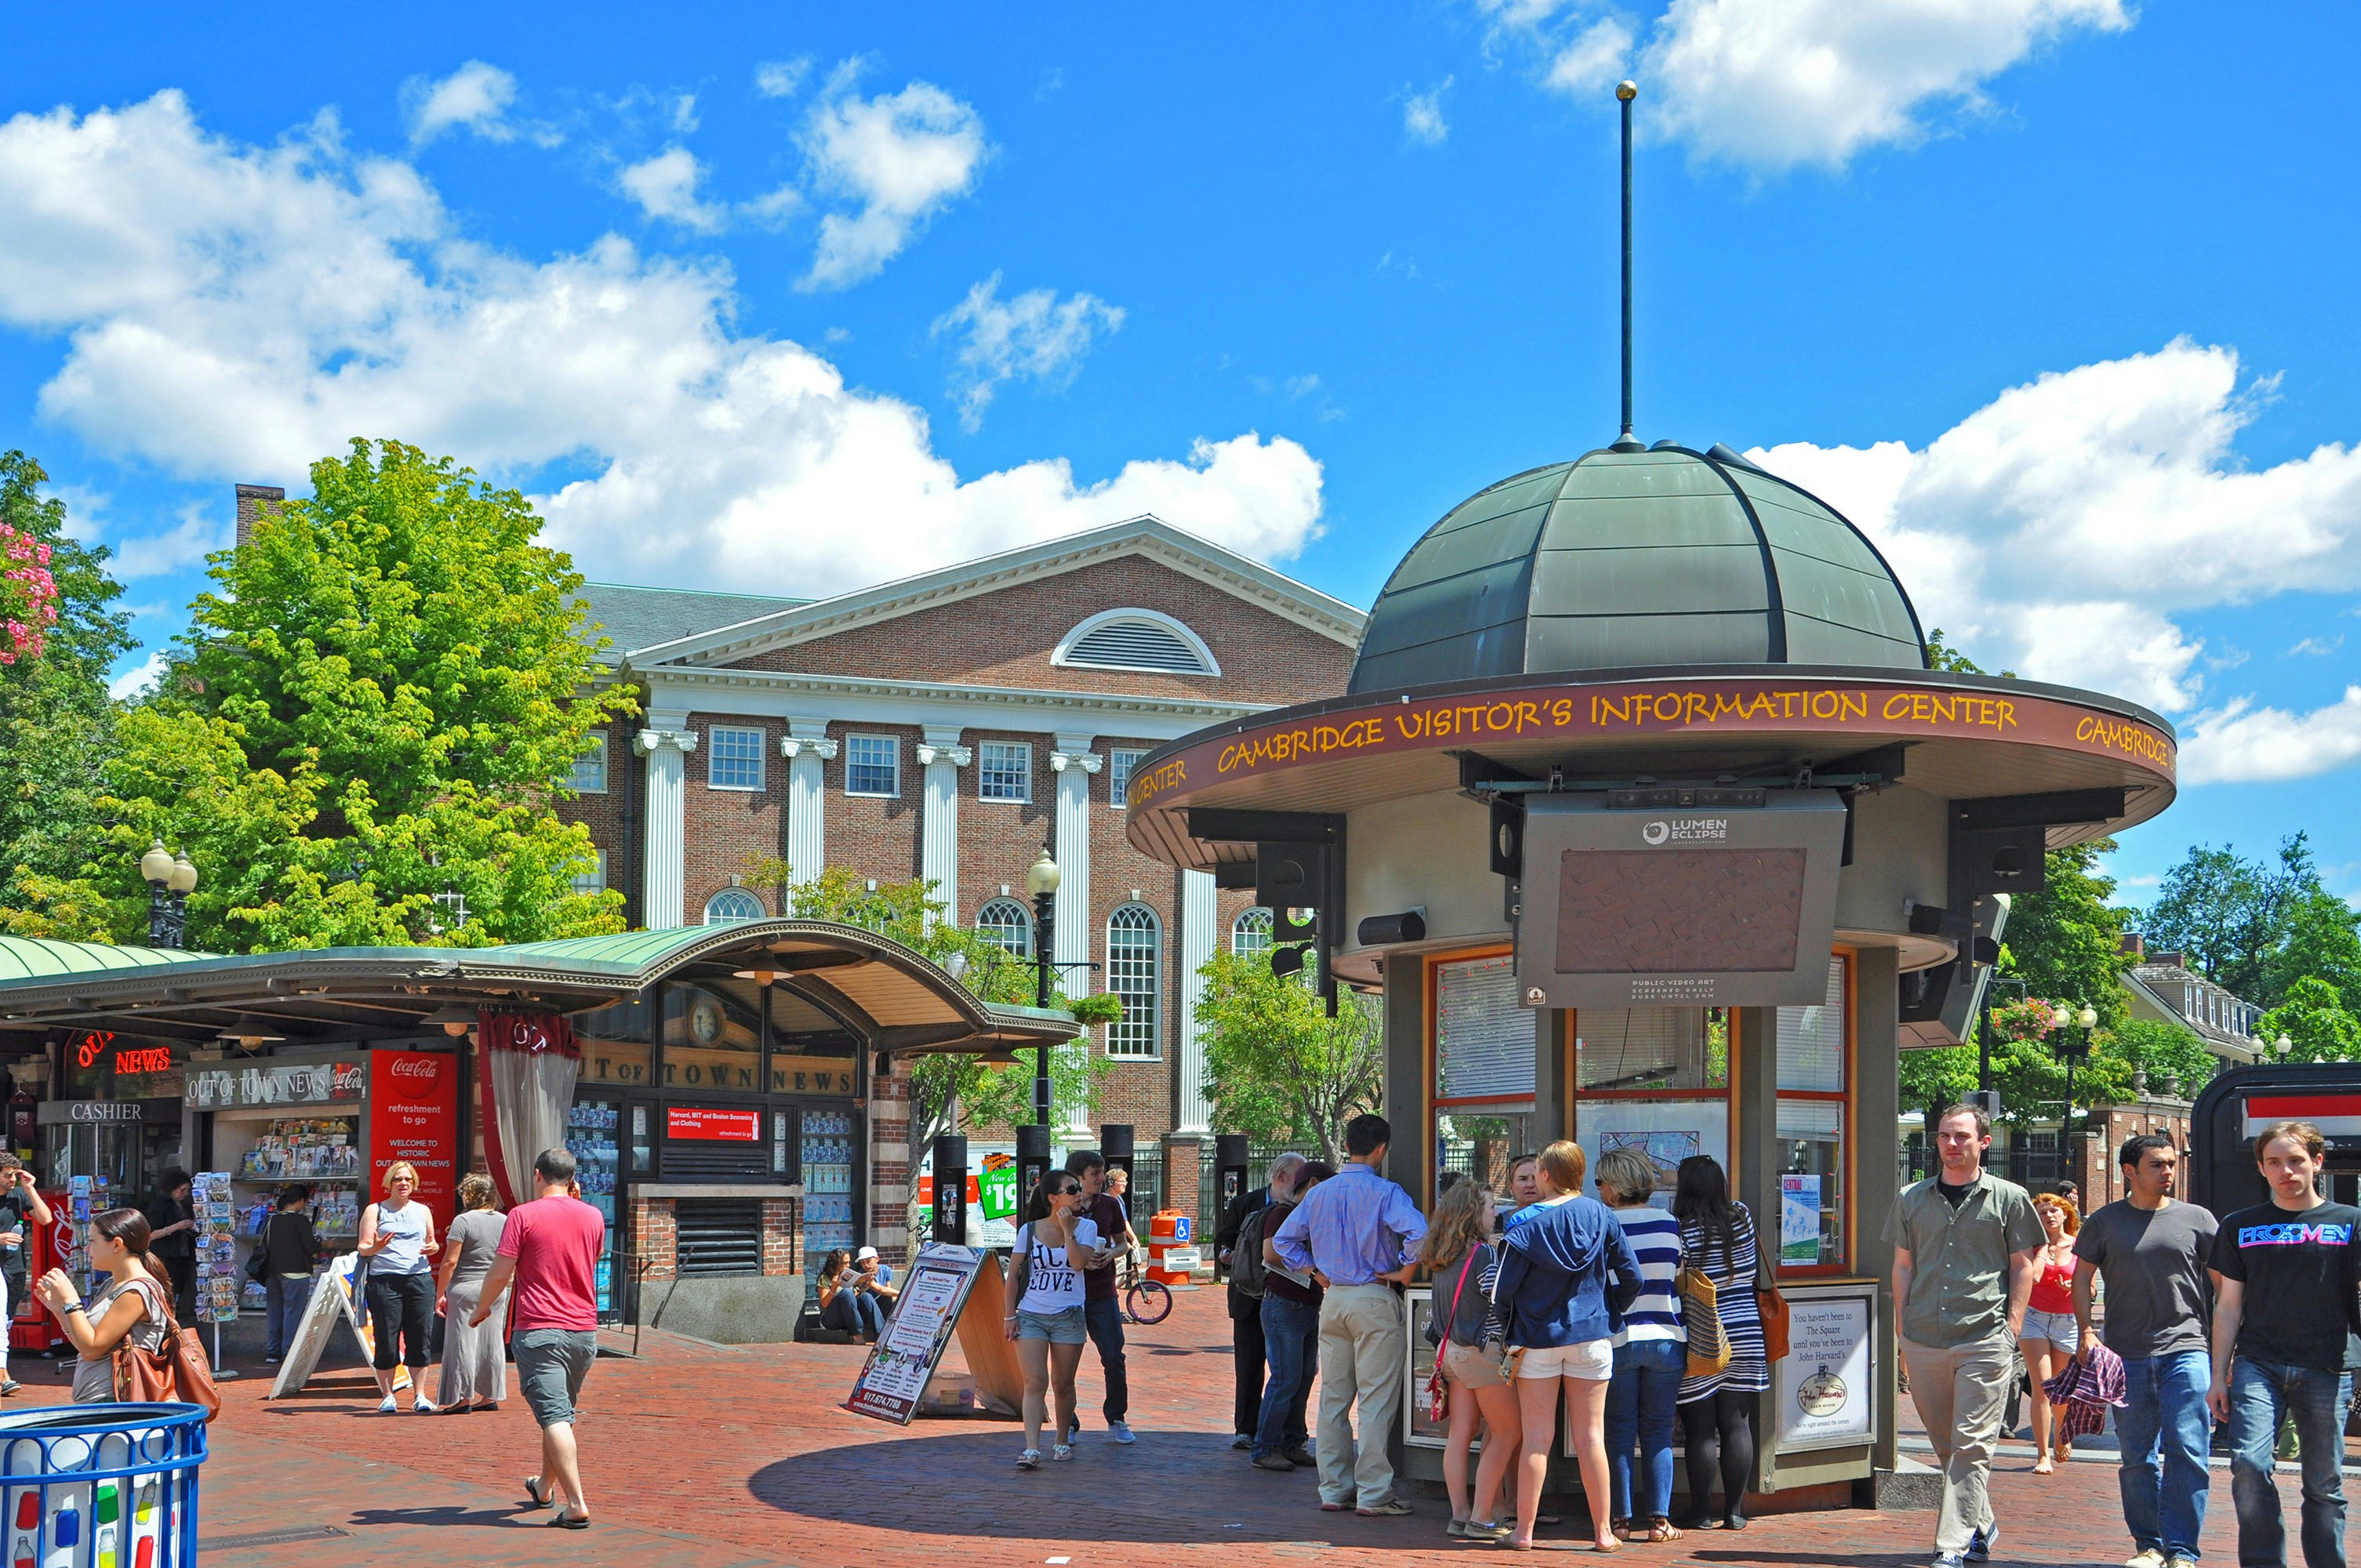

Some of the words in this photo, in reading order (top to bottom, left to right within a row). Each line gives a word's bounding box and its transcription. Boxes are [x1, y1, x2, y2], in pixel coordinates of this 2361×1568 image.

[1218, 718, 1385, 772] CAMBRIDGE
[1394, 699, 1572, 739] VISITOR'S
[1591, 691, 1867, 725] INFORMATION
[1883, 693, 2017, 731] CENTER
[2076, 717, 2167, 767] CAMBRIDGE
[1136, 760, 1186, 804] CENTER
[1672, 819, 1727, 830] LUMEN
[1671, 830, 1726, 839] ECLIPSE
[115, 1047, 170, 1074] NEWS
[663, 1063, 753, 1087] TOWN
[772, 1071, 850, 1092] NEWS
[189, 1080, 216, 1098] OUT
[219, 1079, 236, 1097] OF
[239, 1076, 282, 1095] TOWN
[286, 1073, 326, 1094] NEWS
[71, 1103, 142, 1120] CASHIER
[388, 1104, 441, 1113] refreshment
[989, 1173, 1005, 1182] Now
[1793, 1314, 1807, 1323] You
[1807, 1312, 1829, 1323] haven't
[1830, 1312, 1845, 1321] been
[1807, 1326, 1818, 1335] The
[1819, 1325, 1841, 1336] Square
[1793, 1339, 1807, 1348] until
[1808, 1338, 1829, 1349] you've
[1830, 1338, 1845, 1347] been
[1798, 1352, 1813, 1362] John
